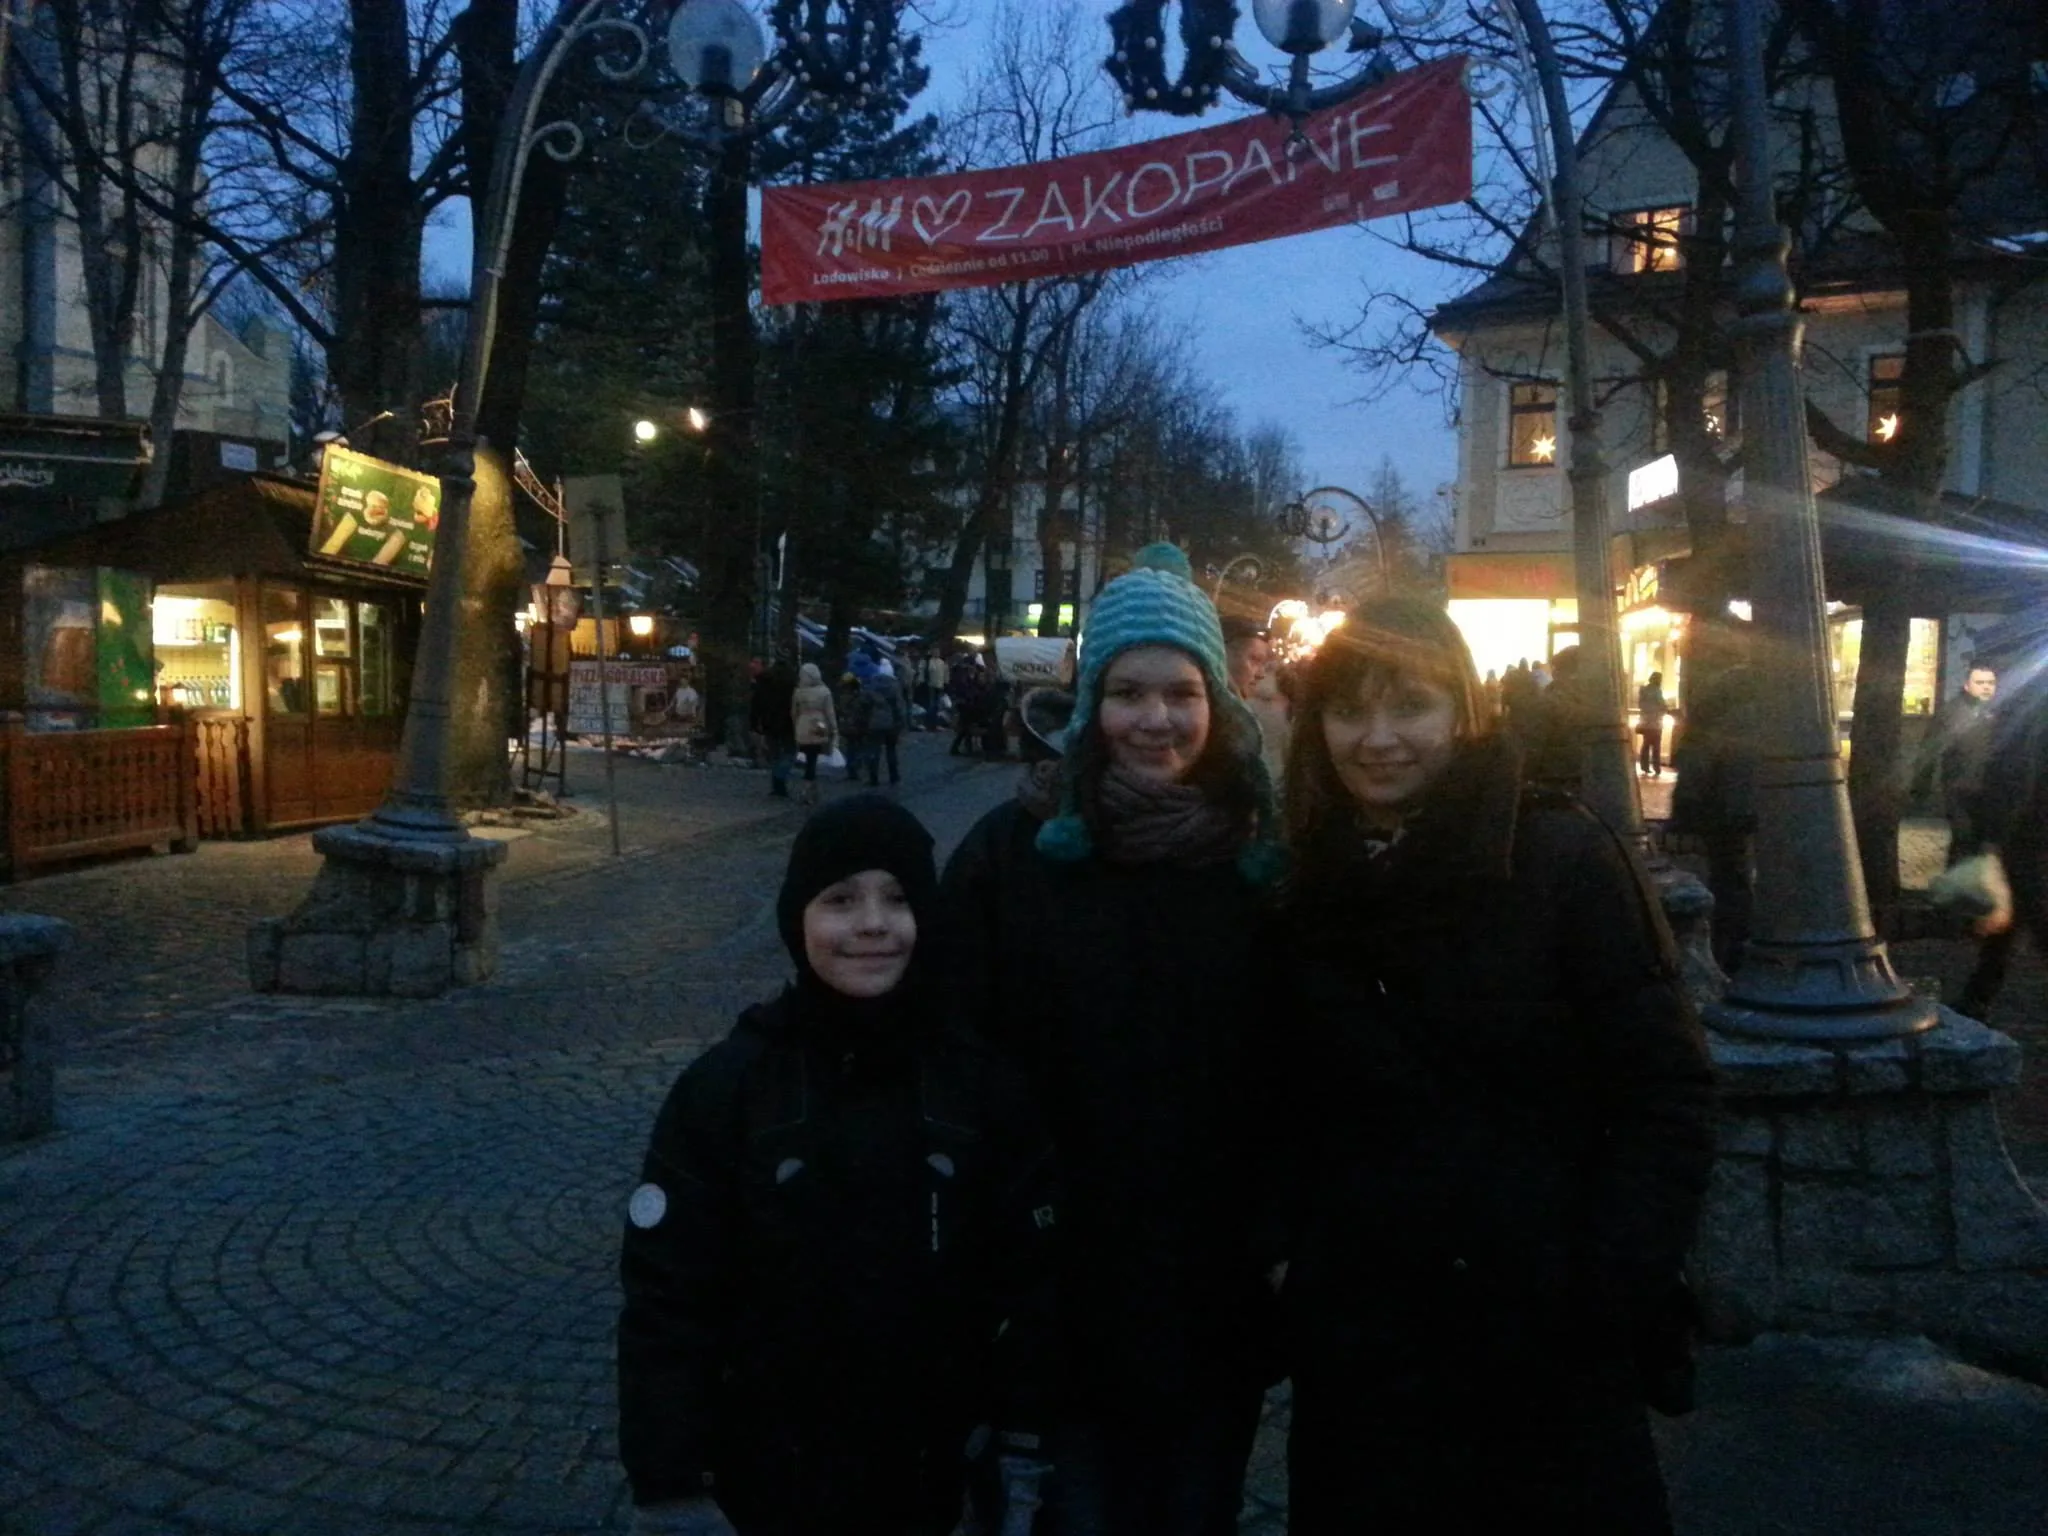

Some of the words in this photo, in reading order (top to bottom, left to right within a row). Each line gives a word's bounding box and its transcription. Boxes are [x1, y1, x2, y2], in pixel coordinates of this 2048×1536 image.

[976, 94, 1399, 241] ZAKOPANE
[813, 267, 889, 285] Lodowisko
[989, 252, 1007, 270] od
